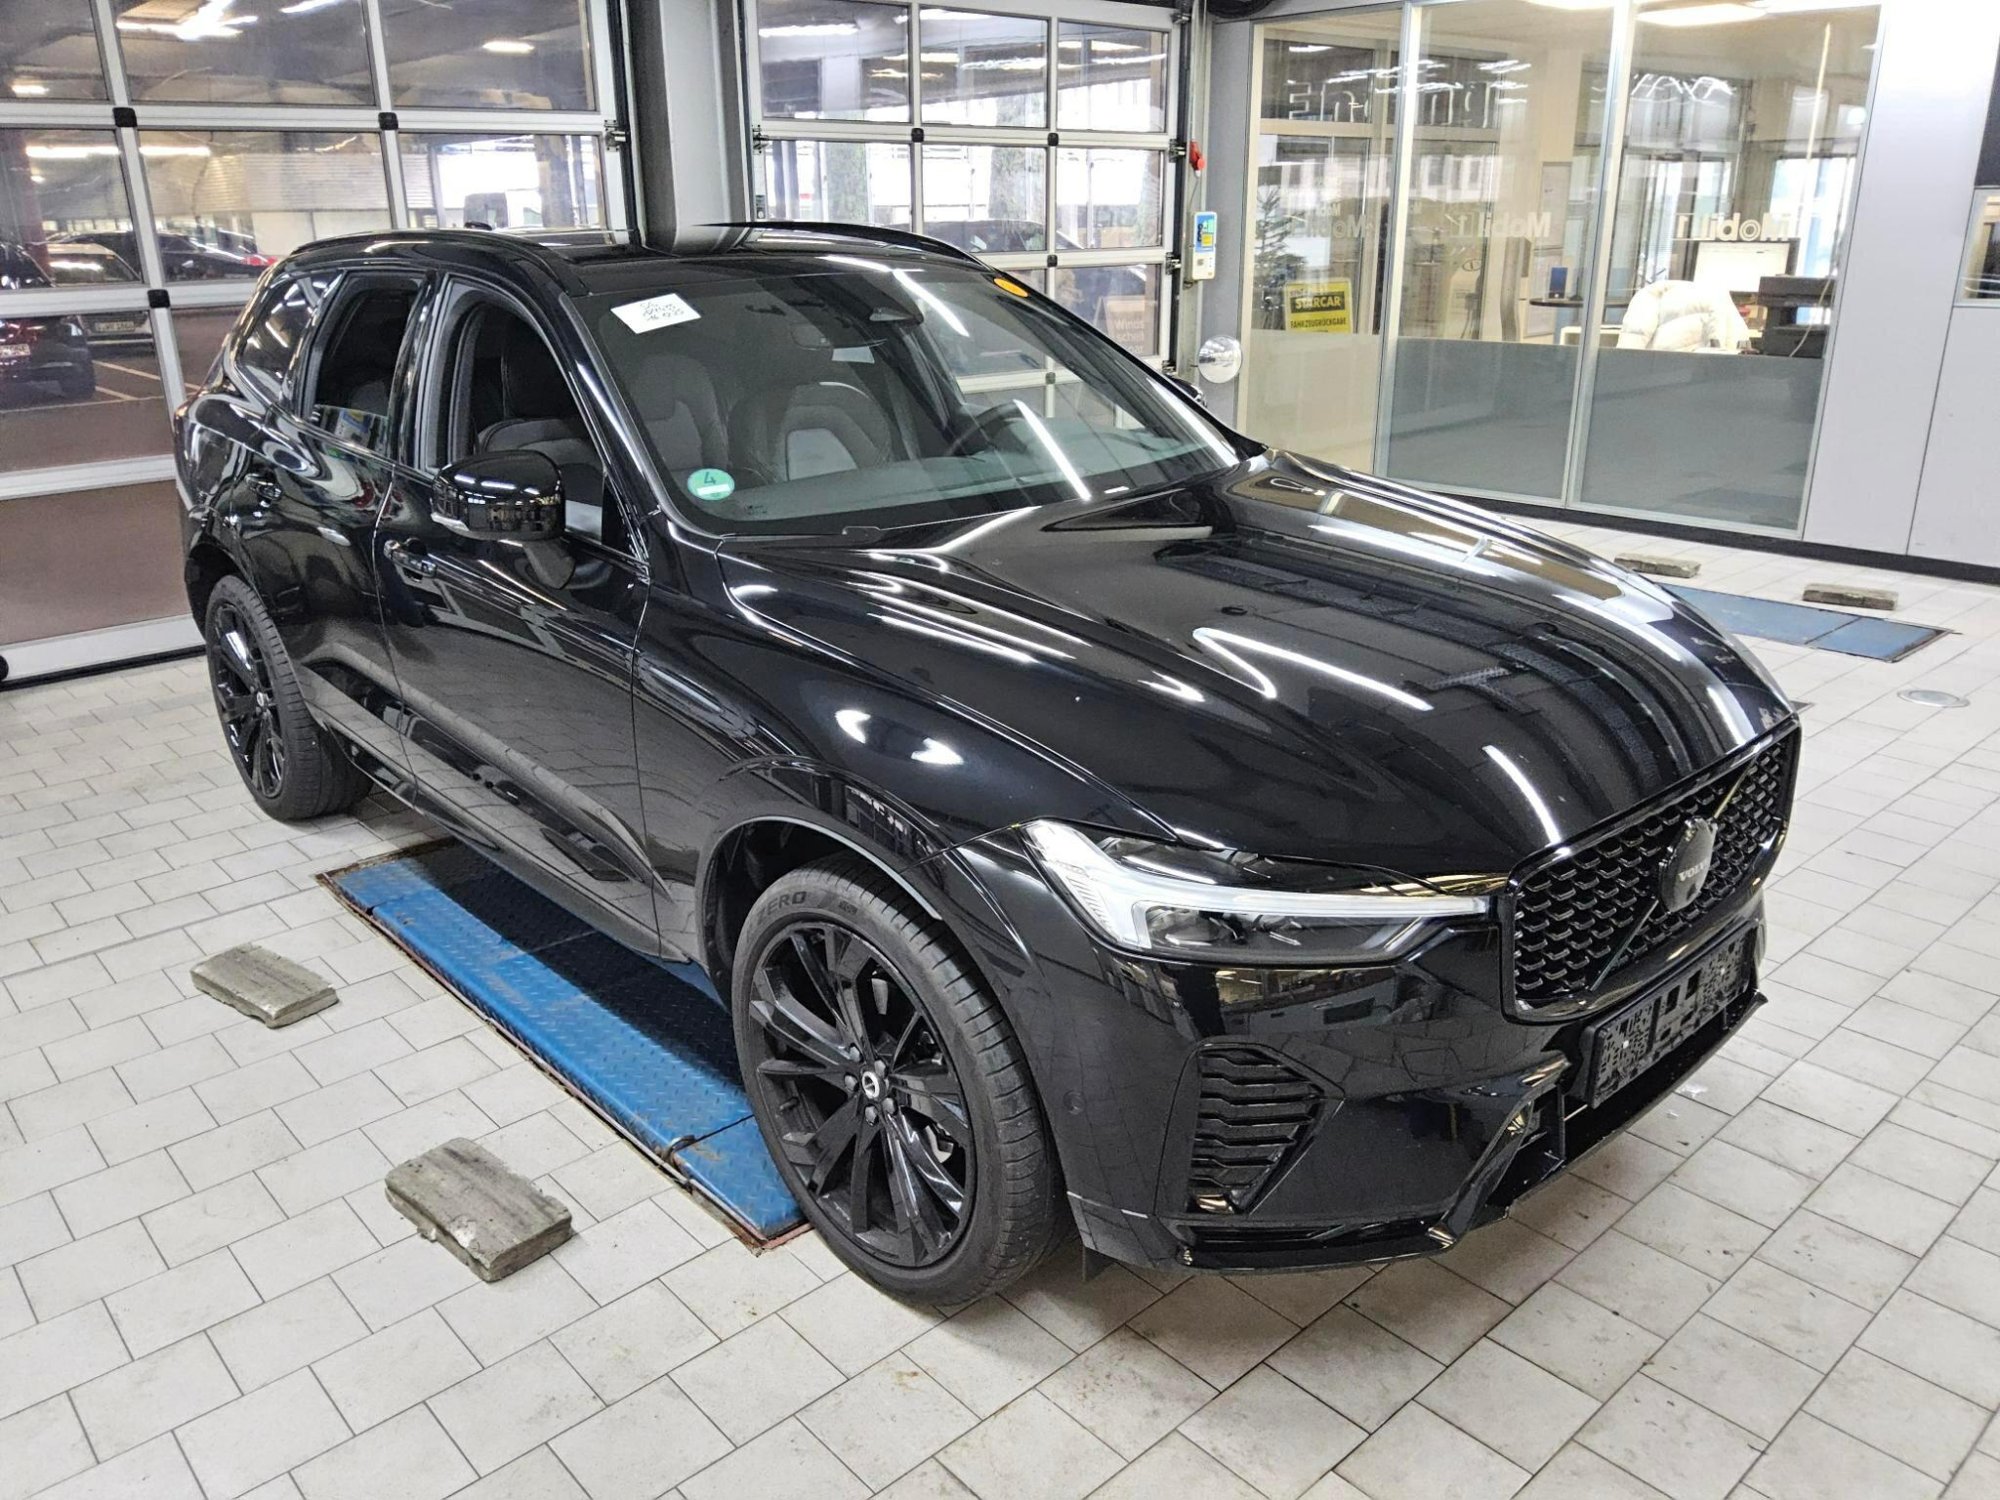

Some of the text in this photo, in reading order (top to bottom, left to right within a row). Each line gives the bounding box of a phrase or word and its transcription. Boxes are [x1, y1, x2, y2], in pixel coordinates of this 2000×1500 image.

[1295, 296, 1341, 310] STARCAR
[704, 472, 716, 485] 4
[757, 891, 807, 925] ZERO
